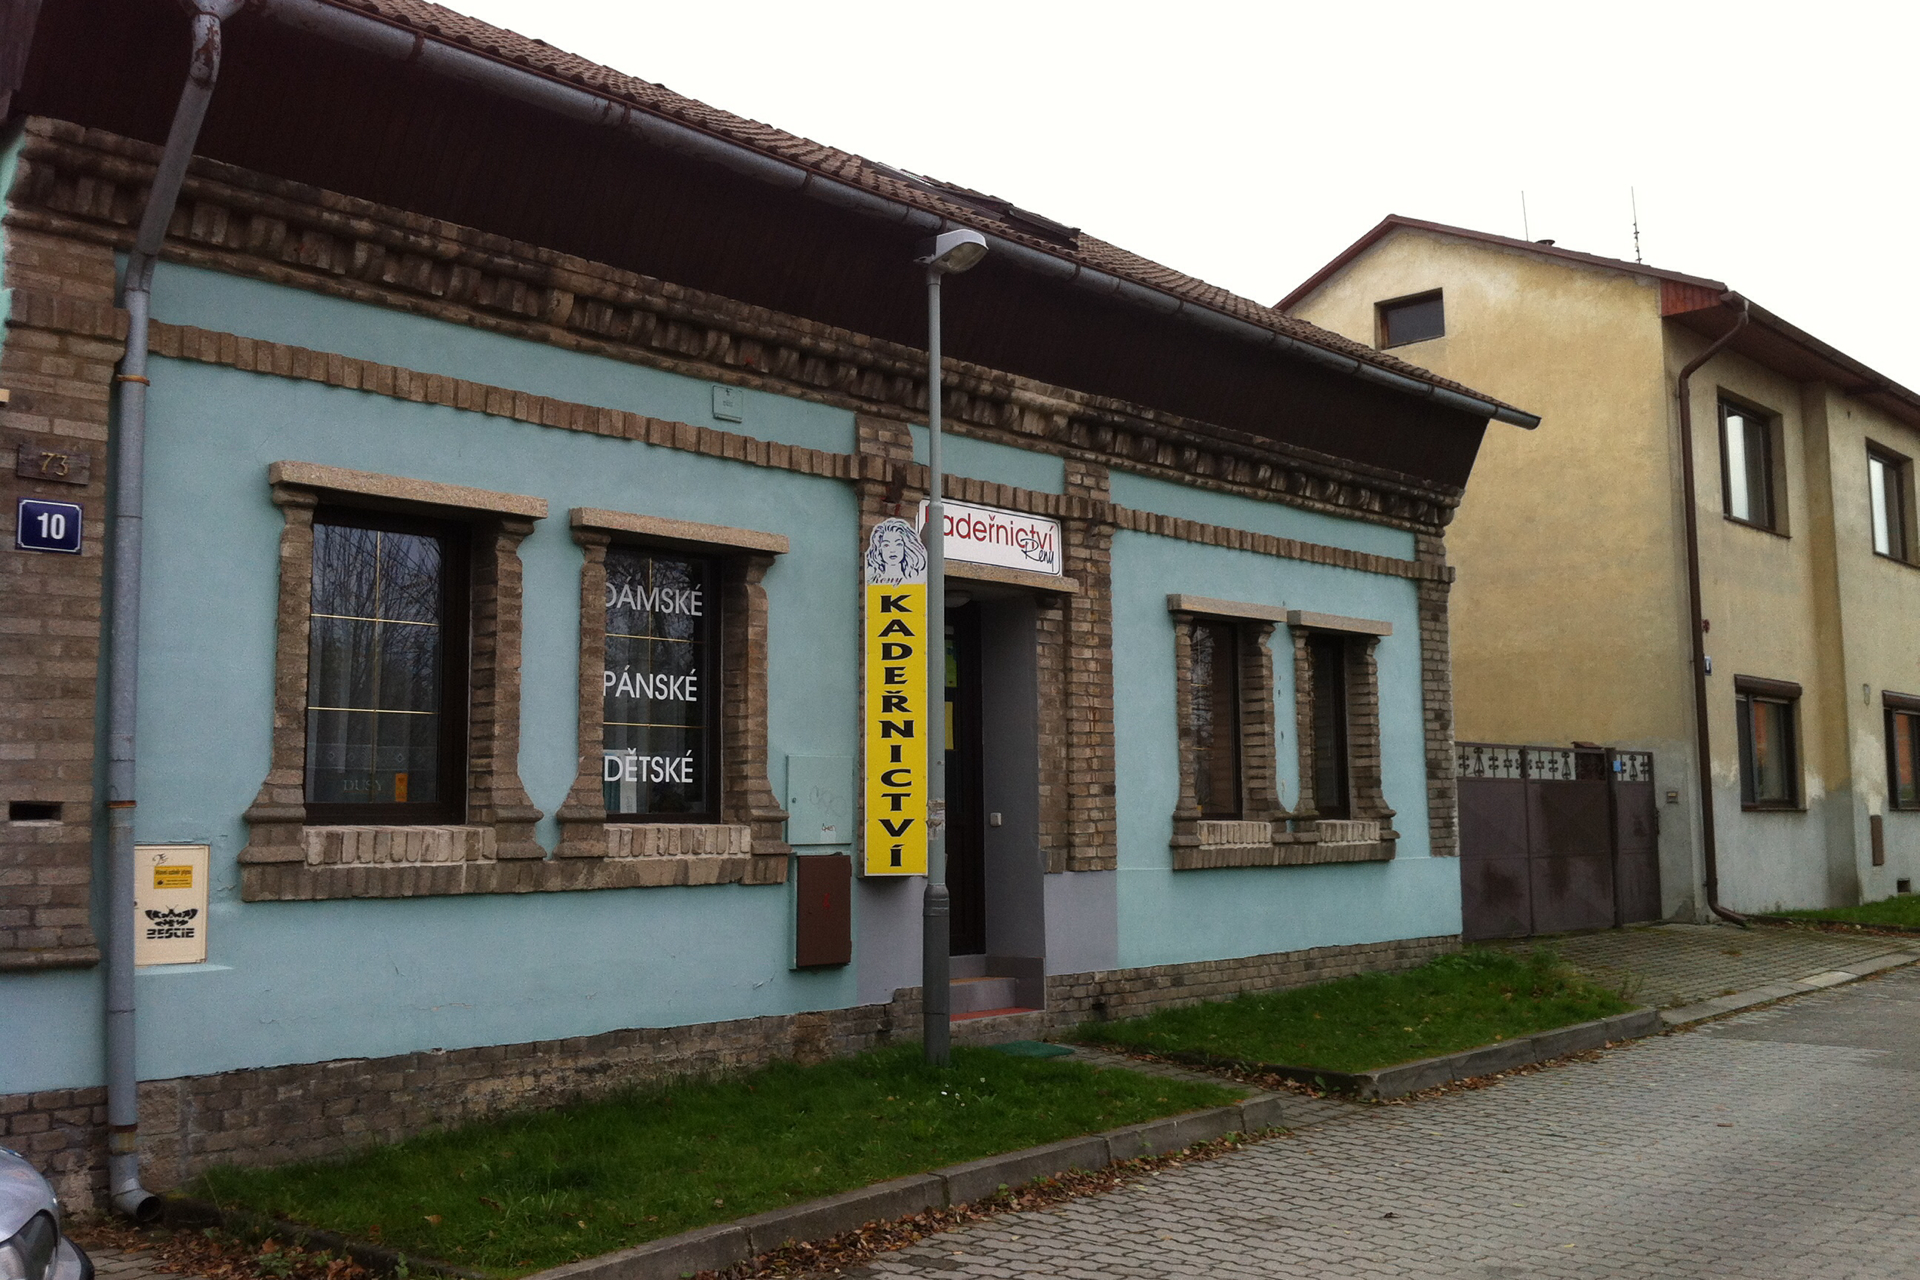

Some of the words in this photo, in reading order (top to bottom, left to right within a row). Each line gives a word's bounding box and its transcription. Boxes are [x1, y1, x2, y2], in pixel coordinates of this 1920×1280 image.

[41, 452, 69, 476] 73
[37, 512, 65, 539] 10
[925, 506, 1054, 551] adeřnictví
[1020, 537, 1055, 573] Reny
[605, 577, 702, 616] DÁMSKÉ
[603, 665, 697, 701] PÁNSKÉ
[878, 594, 915, 867] KADEŘNICTVÍ
[604, 748, 693, 783] DĚTSKÉ
